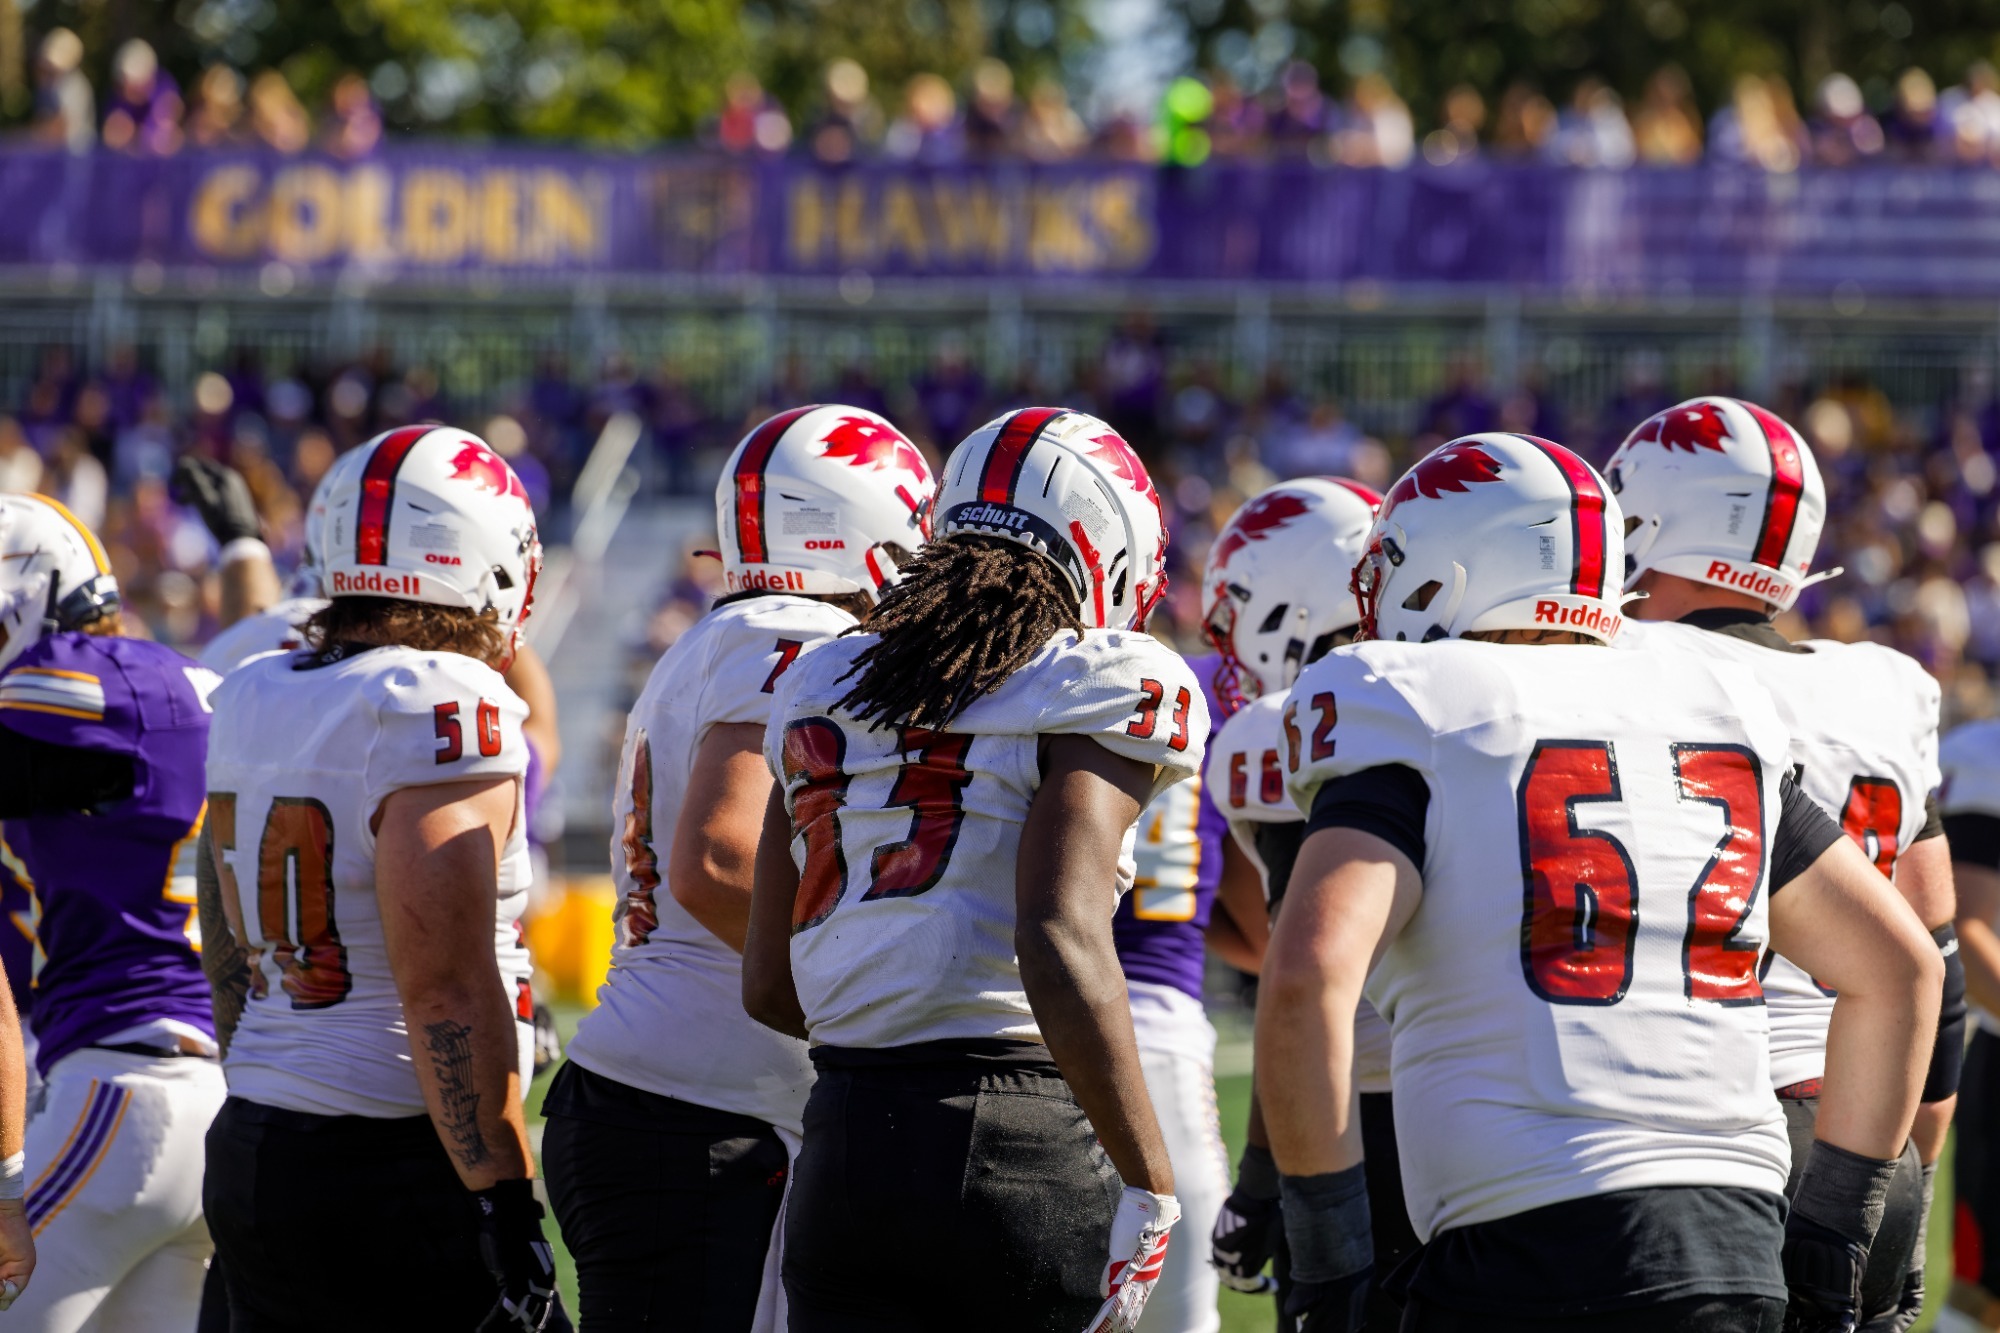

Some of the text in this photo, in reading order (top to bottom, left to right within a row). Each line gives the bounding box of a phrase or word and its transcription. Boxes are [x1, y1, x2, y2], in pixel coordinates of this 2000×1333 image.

[192, 164, 1157, 270] GOLDEN HAWKS
[958, 503, 1030, 531] schutt
[425, 553, 462, 566] OUA
[804, 540, 846, 551] OUA
[332, 571, 421, 596] Riddell
[727, 569, 805, 592] Riddell
[1706, 560, 1793, 604] Riddell
[1535, 600, 1622, 640] Riddell
[433, 696, 503, 765] 50
[1126, 678, 1192, 752] 33
[1284, 691, 1338, 774] 62
[1229, 748, 1284, 809] 66
[1517, 738, 1767, 1008] 62
